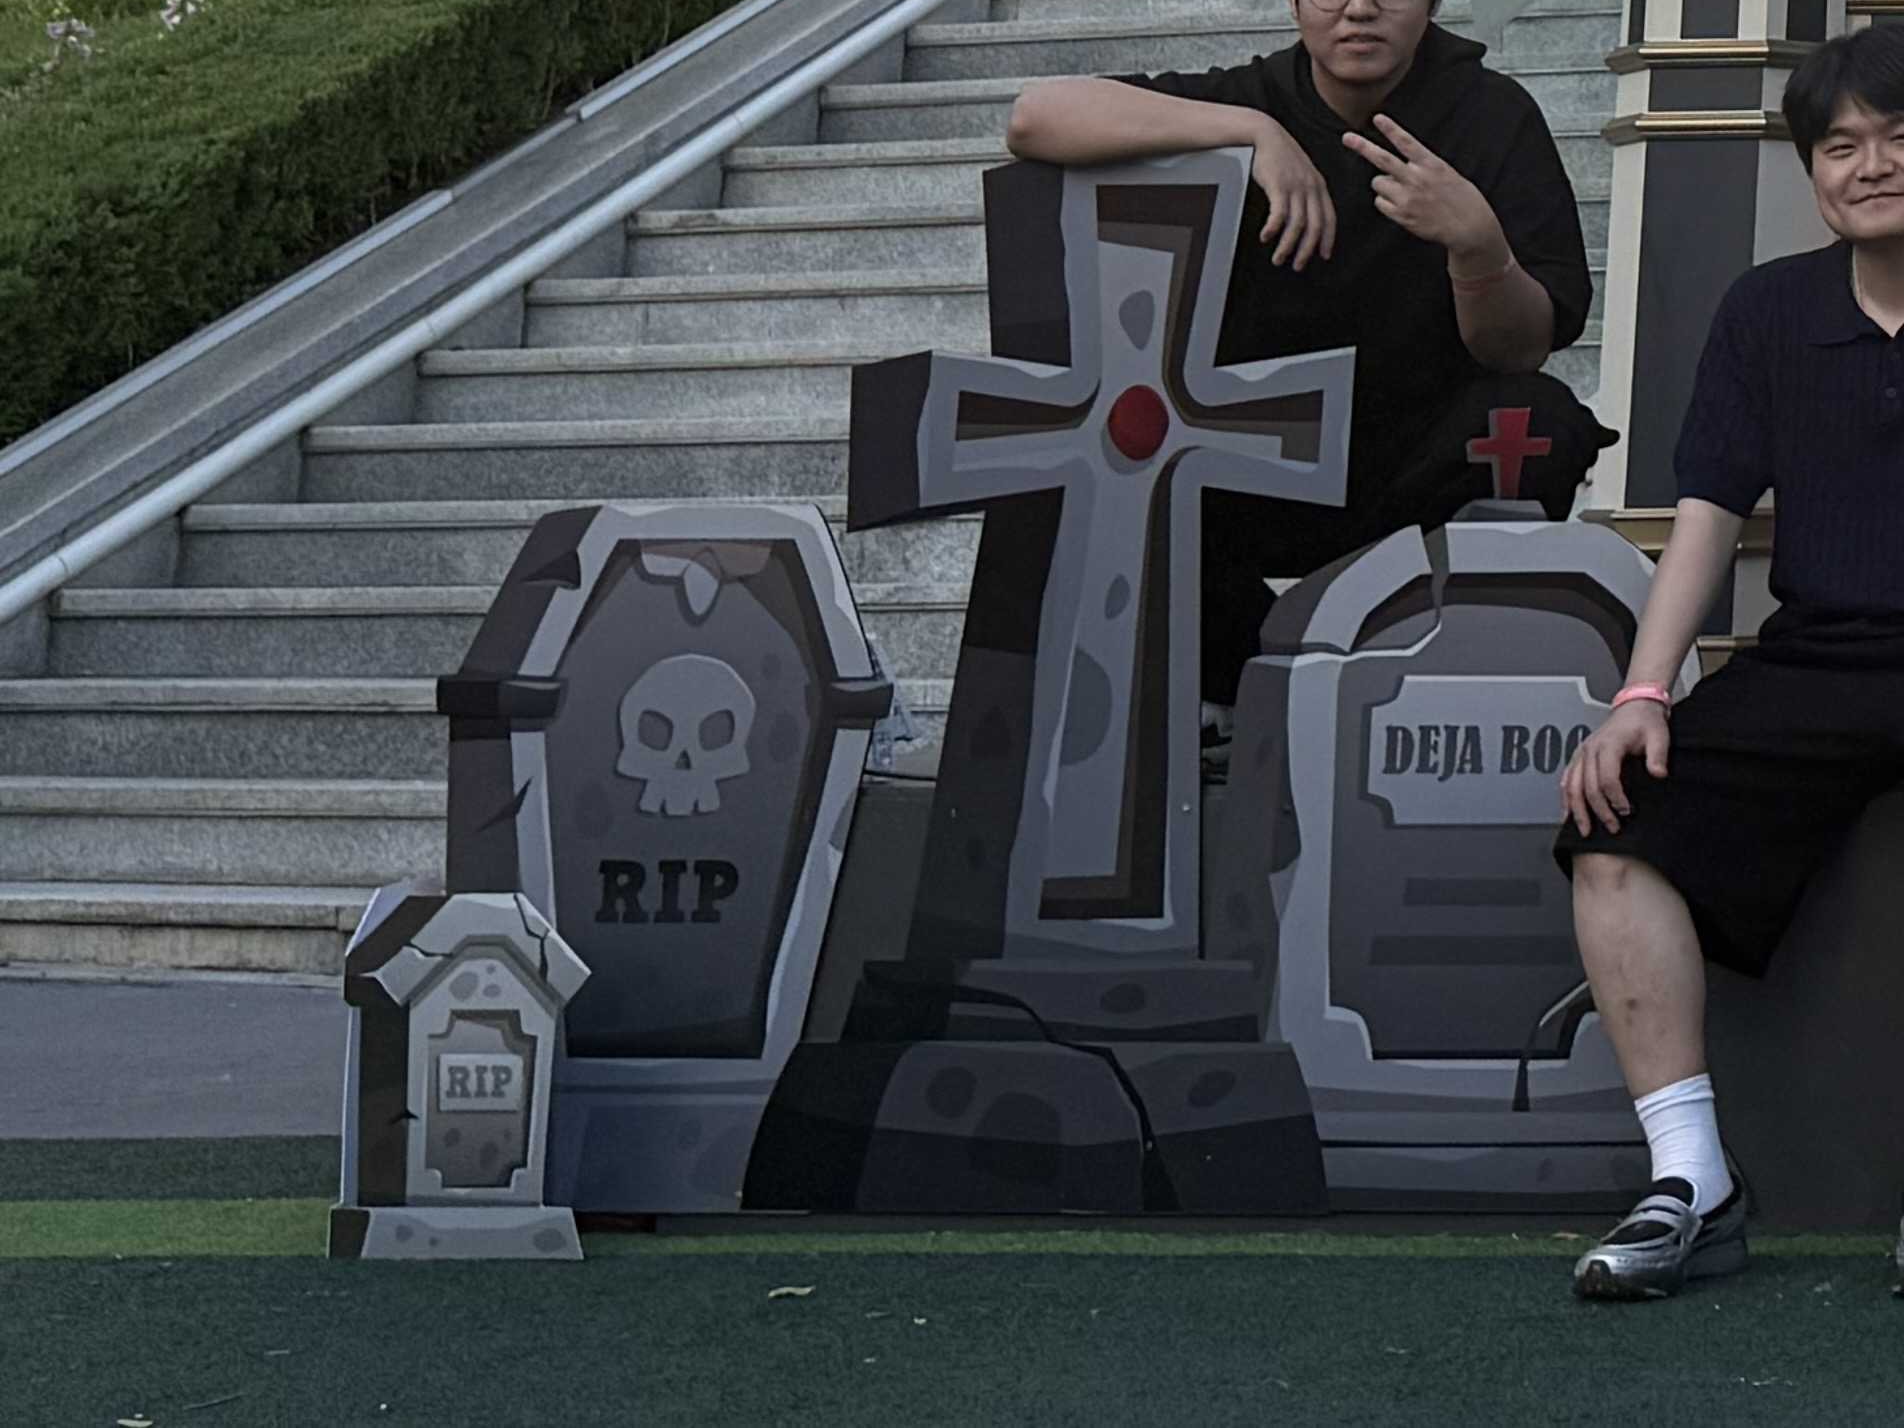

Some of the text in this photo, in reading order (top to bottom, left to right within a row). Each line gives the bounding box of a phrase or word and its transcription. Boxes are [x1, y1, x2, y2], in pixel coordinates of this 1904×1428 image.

[1381, 724, 1484, 783] DEJA
[594, 858, 739, 925] RIP
[445, 1063, 514, 1100] RIP
